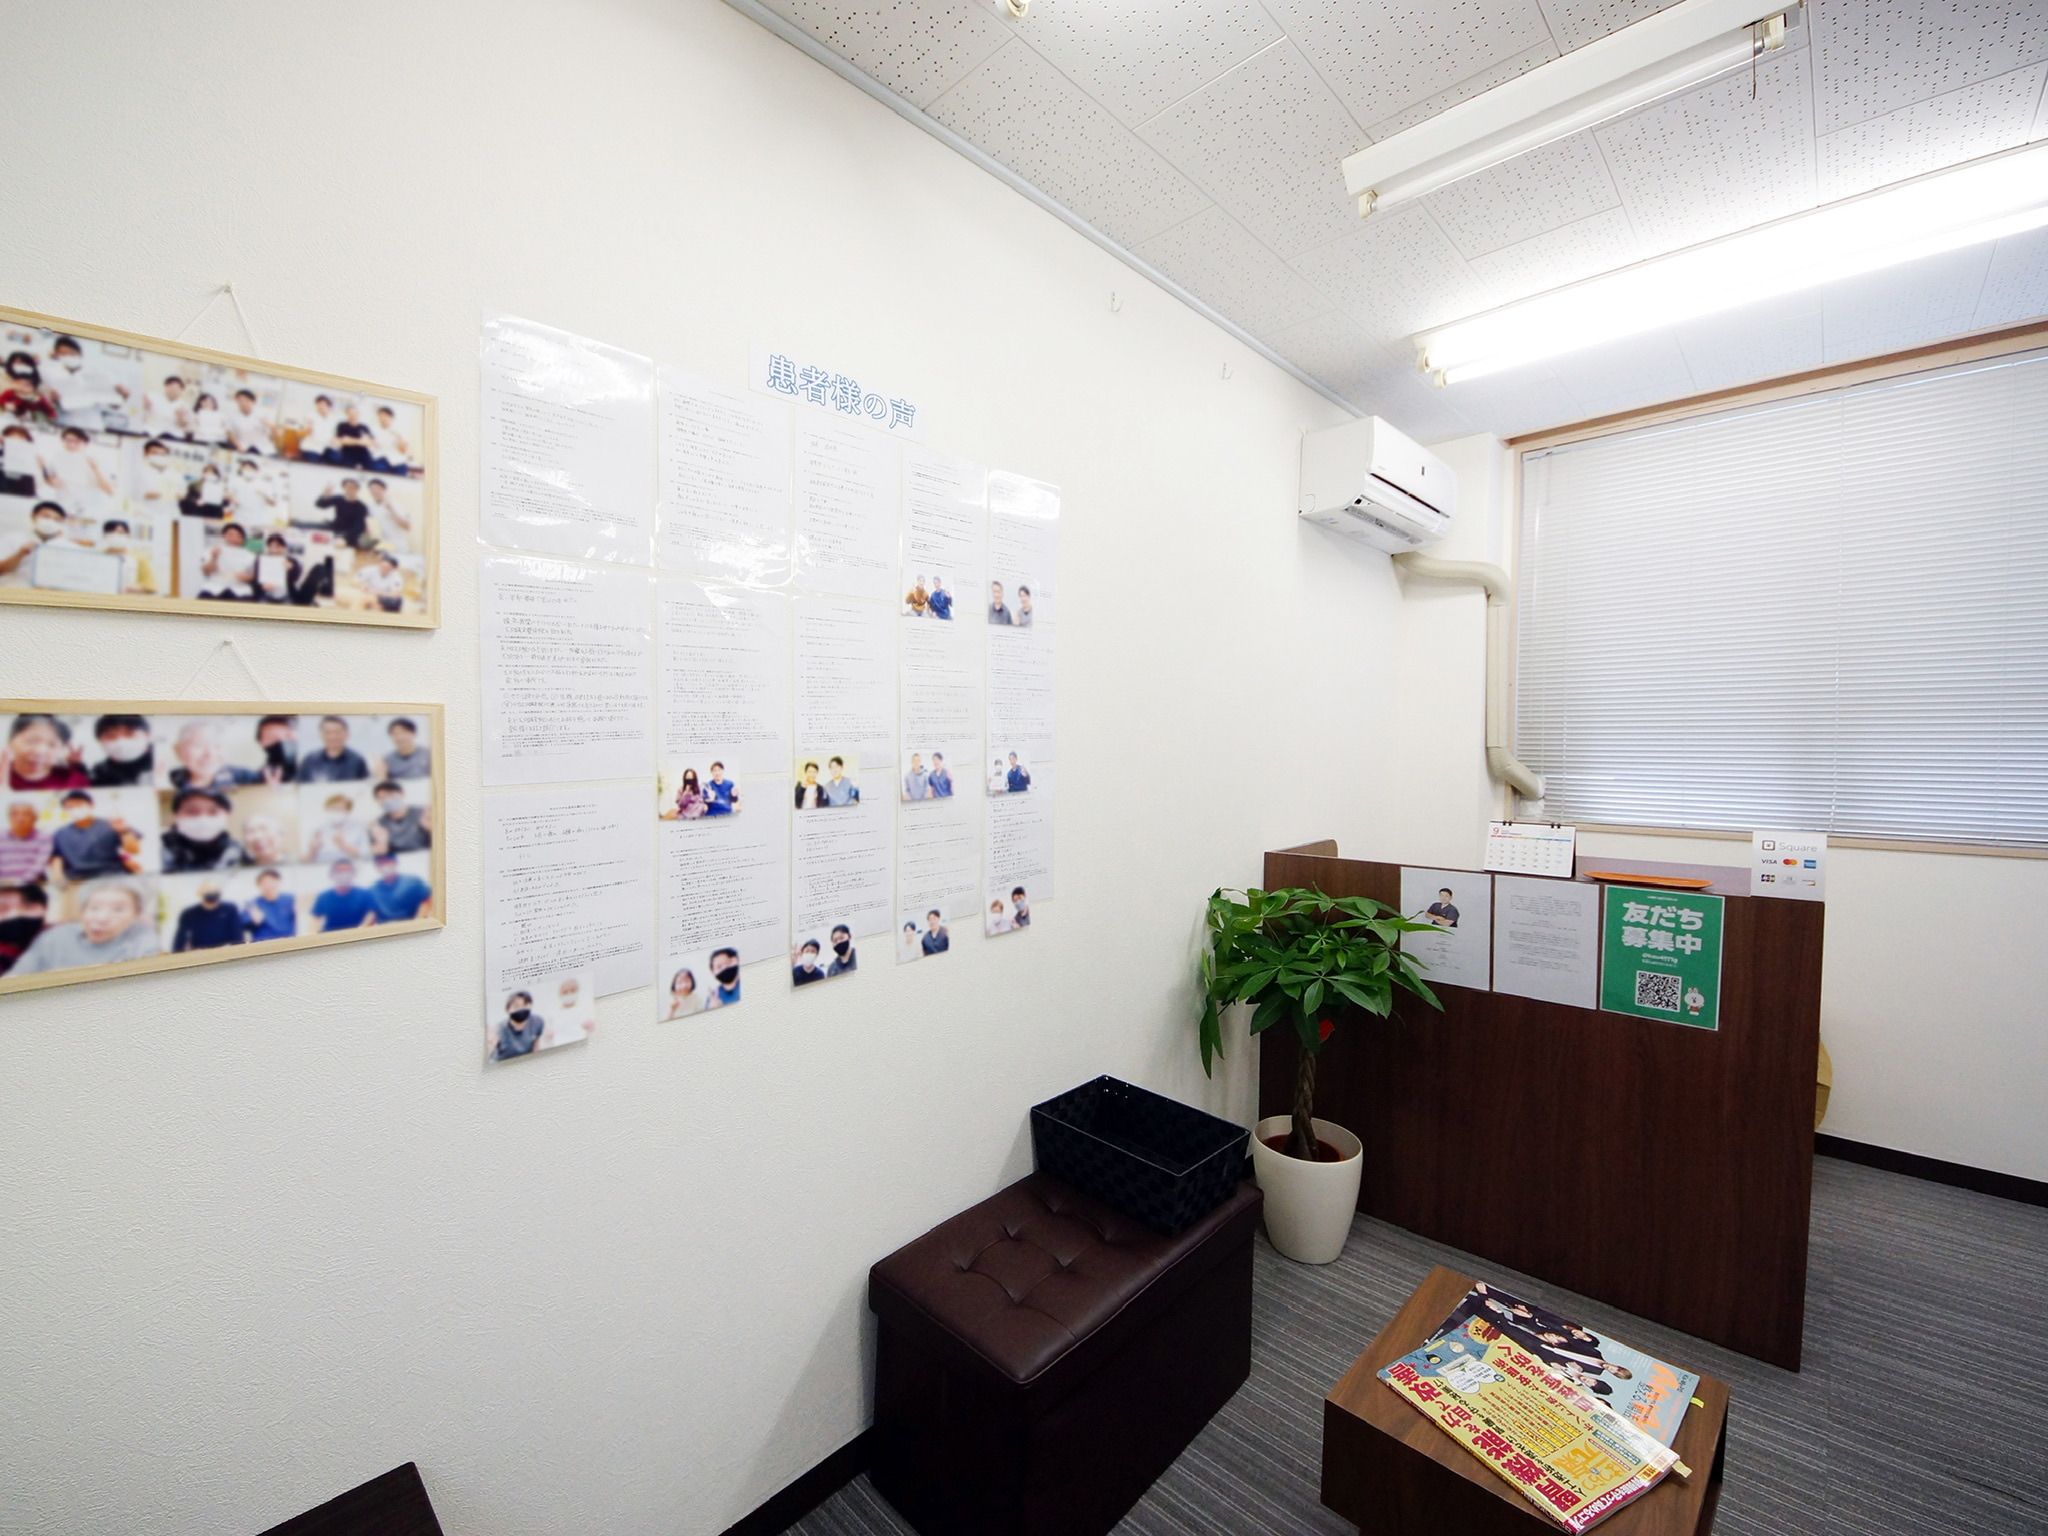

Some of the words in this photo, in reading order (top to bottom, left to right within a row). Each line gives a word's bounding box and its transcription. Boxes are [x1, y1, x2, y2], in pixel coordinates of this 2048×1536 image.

[766, 354, 916, 429] 患者様の声
[1779, 842, 1818, 853] Square
[1621, 926, 1702, 956] 募集中
[1622, 901, 1704, 931] 友だち
[1492, 1358, 1594, 1431] ホントに効いた安眠術
[1497, 1345, 1595, 1413] 血栓症を防ぐ
[1387, 1363, 1582, 1513] 腎機能を自力で改善
